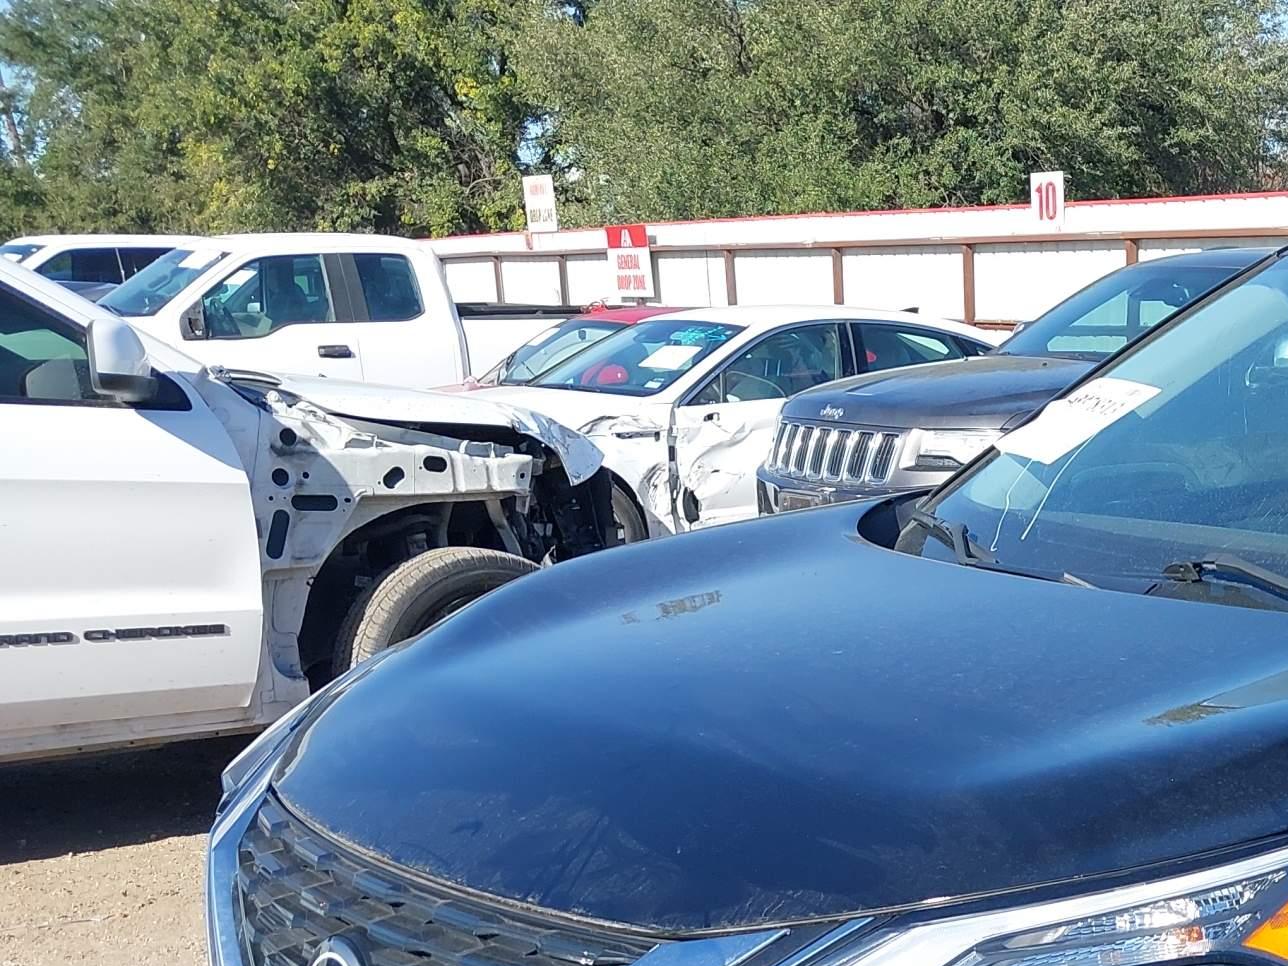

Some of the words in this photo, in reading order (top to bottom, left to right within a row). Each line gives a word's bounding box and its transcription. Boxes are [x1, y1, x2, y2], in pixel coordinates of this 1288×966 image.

[1035, 181, 1057, 221] 10
[616, 254, 640, 270] GENERAL
[616, 274, 632, 290] DROP
[633, 274, 647, 290] ZONE
[83, 624, 227, 641] CHEROKEE
